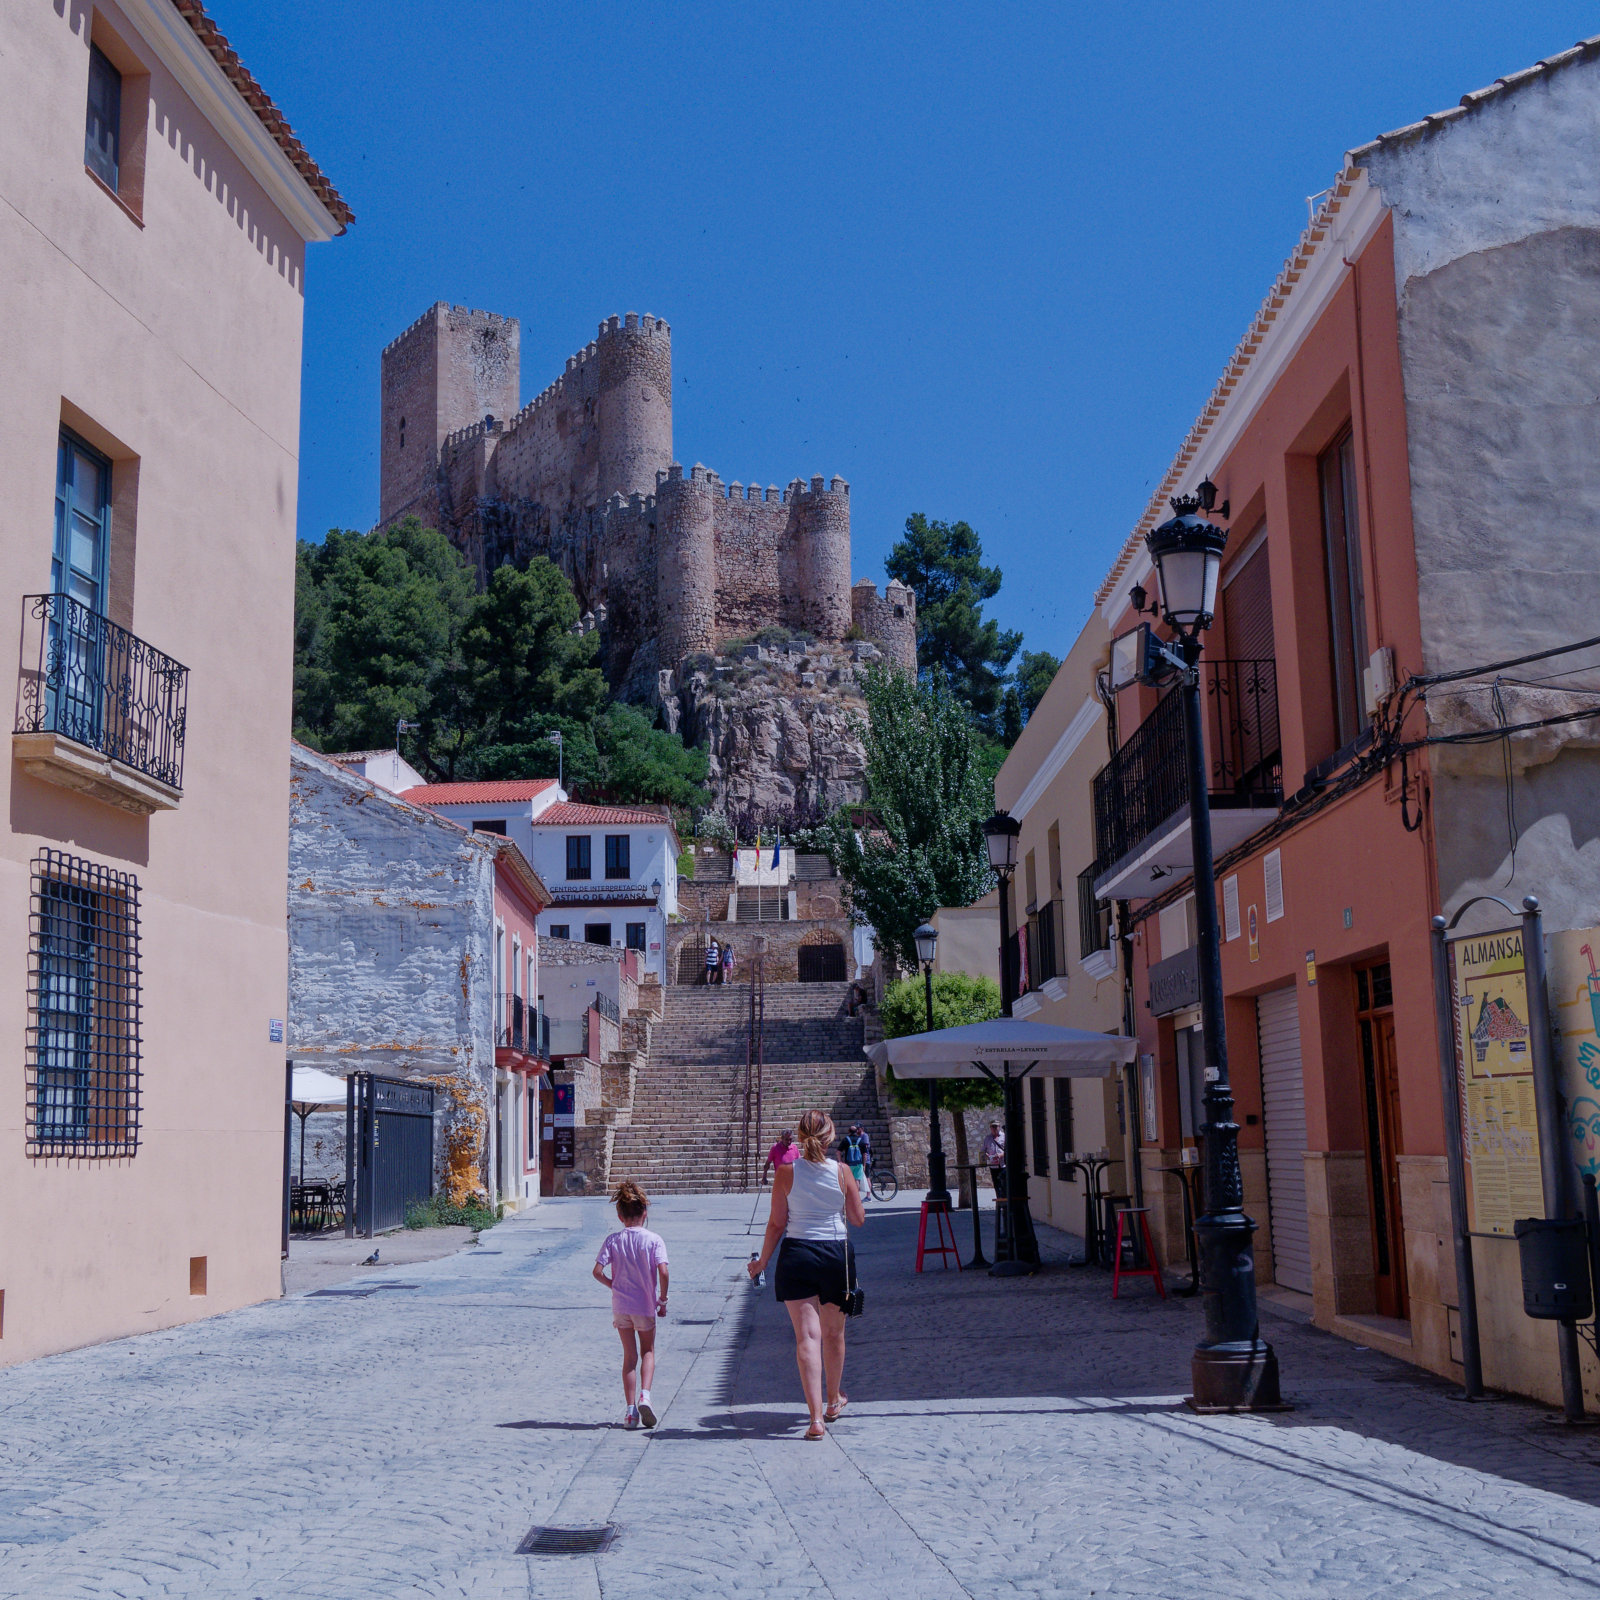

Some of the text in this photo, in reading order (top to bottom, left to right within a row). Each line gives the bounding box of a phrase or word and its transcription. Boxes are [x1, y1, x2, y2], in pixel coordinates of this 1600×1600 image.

[549, 885, 578, 893] CENTRO
[591, 893, 604, 901] DE
[604, 892, 647, 900] ALMANSA
[1462, 935, 1524, 967] ALMANSA
